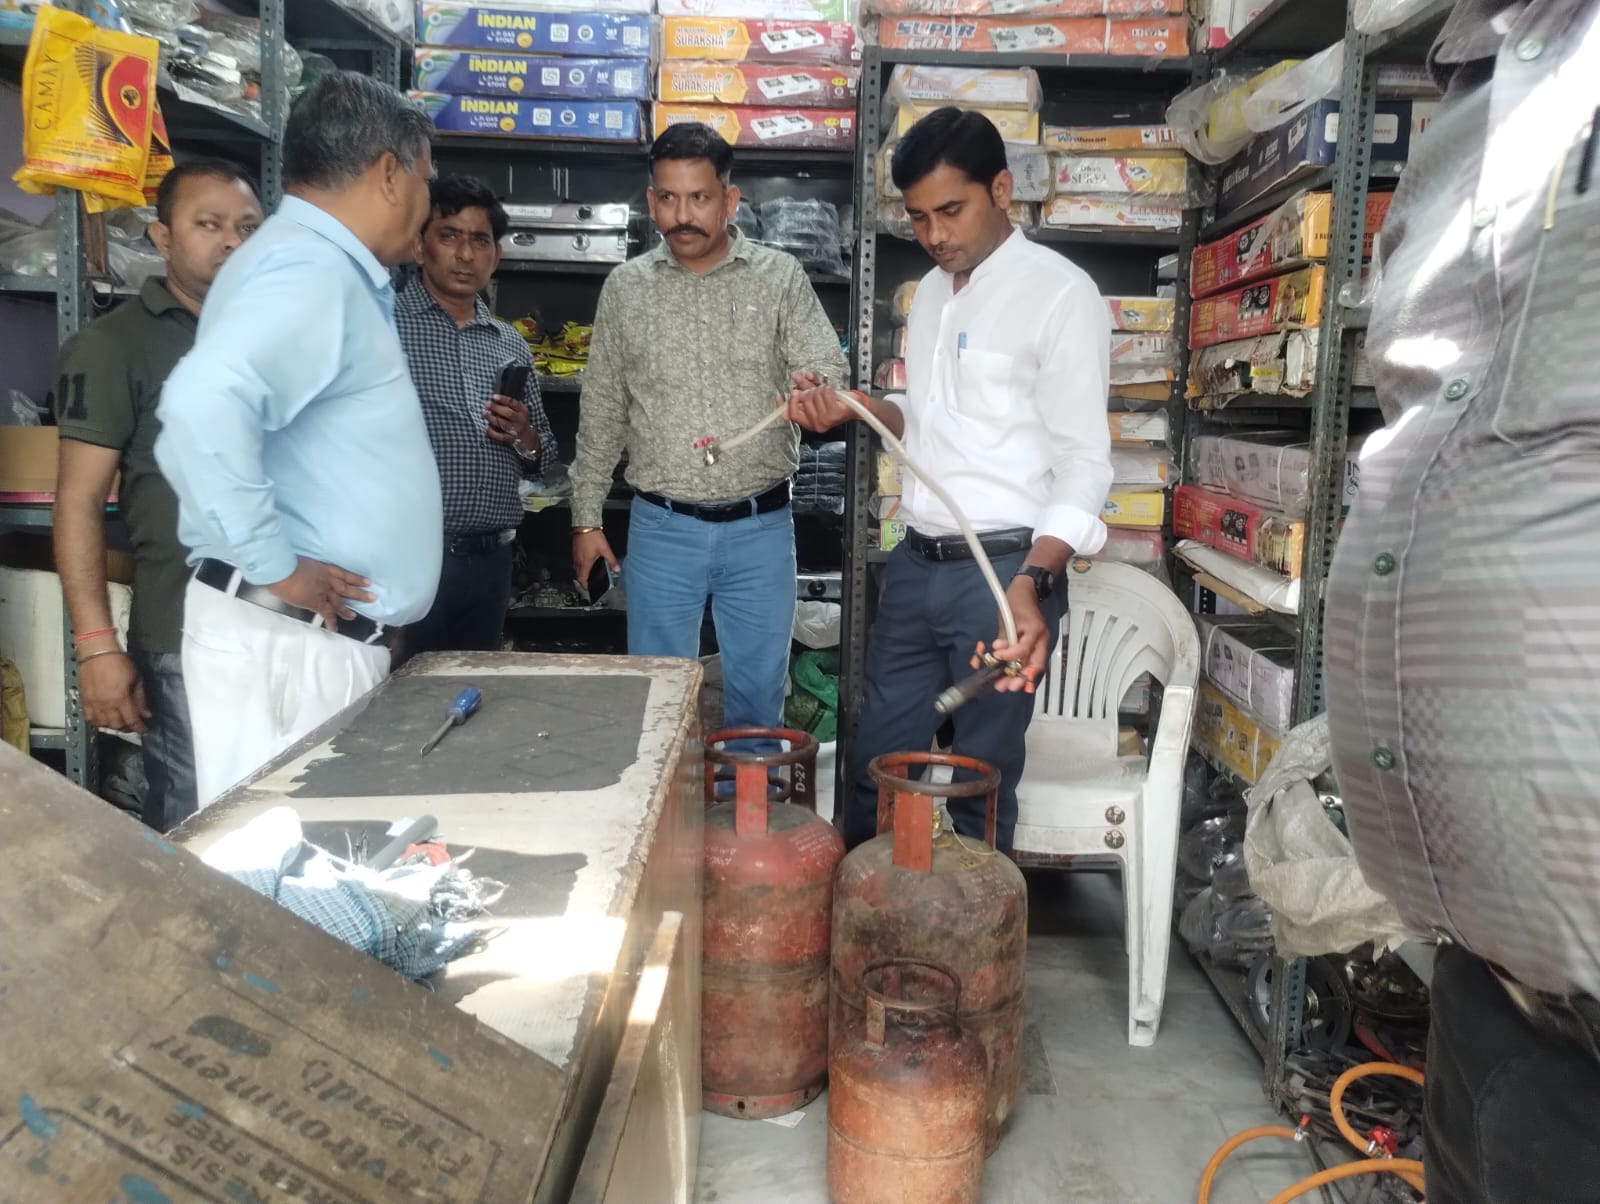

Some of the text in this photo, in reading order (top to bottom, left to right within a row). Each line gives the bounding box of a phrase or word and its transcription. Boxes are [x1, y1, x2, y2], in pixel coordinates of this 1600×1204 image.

[478, 14, 536, 30] INDIAN
[896, 20, 976, 38] SUPER
[675, 33, 725, 48] SURAKSHA
[469, 58, 527, 75] INDIAN
[35, 54, 62, 130] CAMAY
[672, 79, 722, 93] SURAKSHA
[461, 99, 519, 115] INDIAN
[794, 762, 806, 792] D-27
